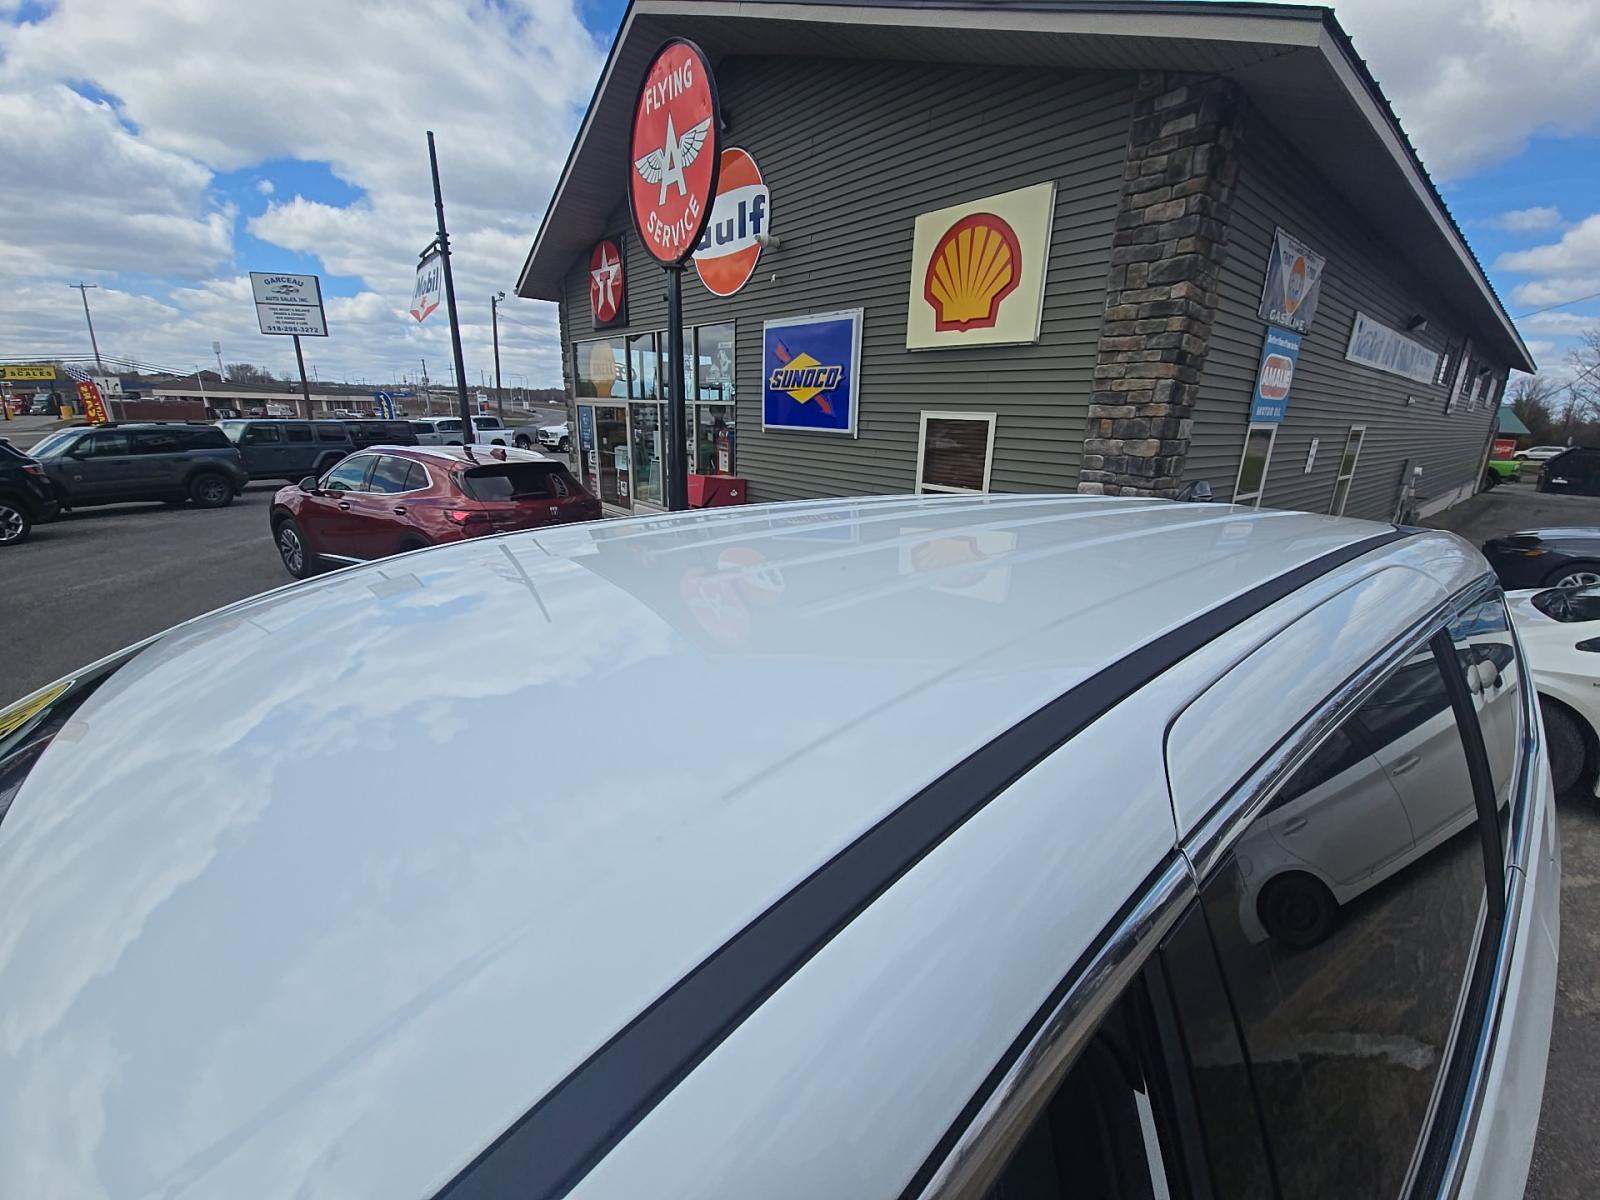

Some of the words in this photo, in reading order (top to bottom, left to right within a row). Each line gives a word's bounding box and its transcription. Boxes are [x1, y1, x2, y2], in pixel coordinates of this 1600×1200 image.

[645, 58, 693, 115] FLYING
[647, 193, 700, 248] SERVICE
[264, 277, 304, 287] GARCEAU
[415, 266, 439, 299] Mobil
[771, 367, 840, 389] SUNOCO
[1261, 366, 1292, 389] AMALIE
